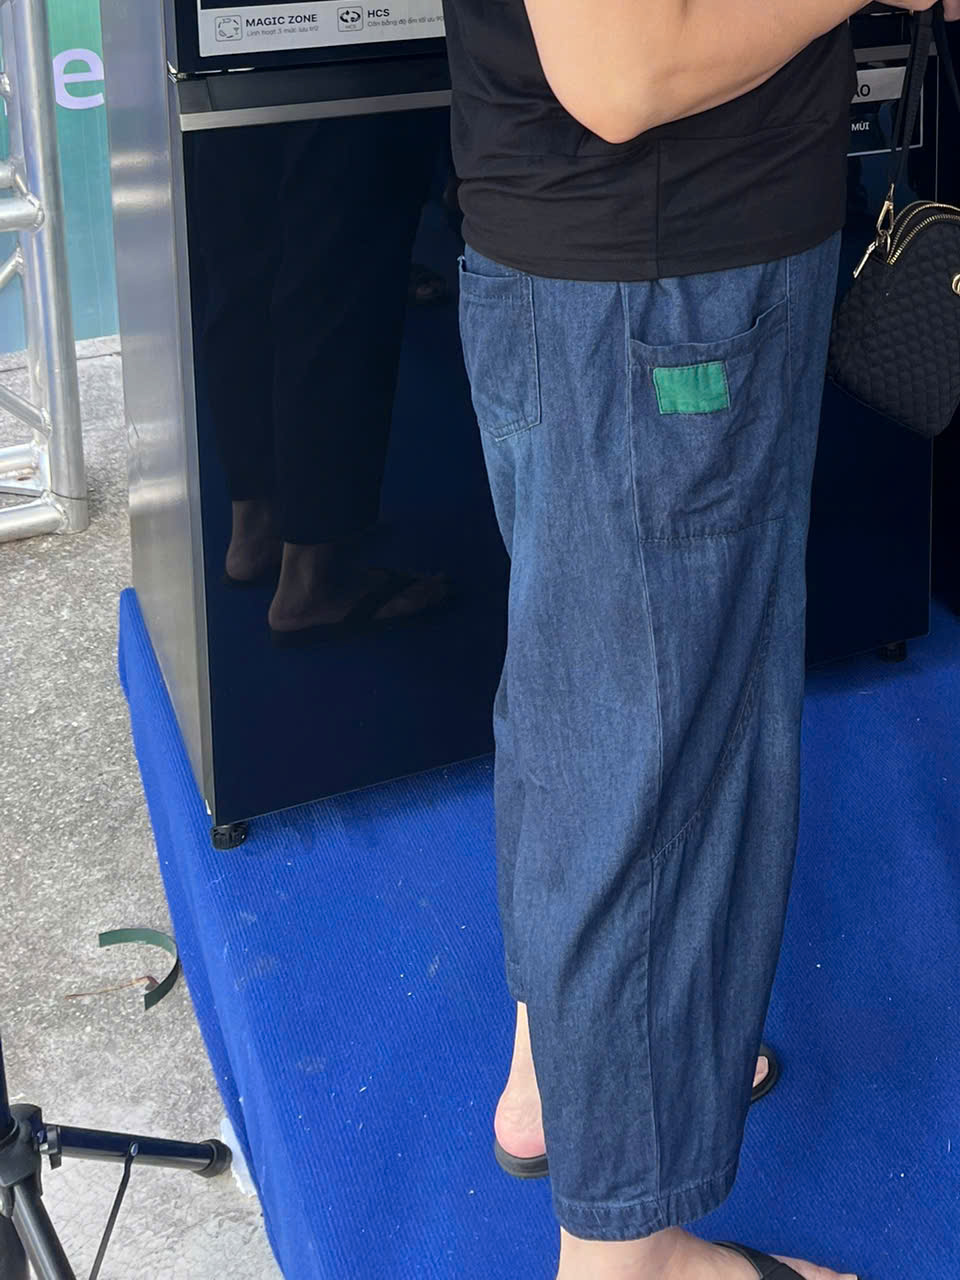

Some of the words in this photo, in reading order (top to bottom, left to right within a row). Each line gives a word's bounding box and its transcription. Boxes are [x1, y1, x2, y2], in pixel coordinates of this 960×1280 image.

[367, 8, 390, 18] HCS
[245, 16, 285, 28] MAGIC
[287, 13, 318, 25] ZONE
